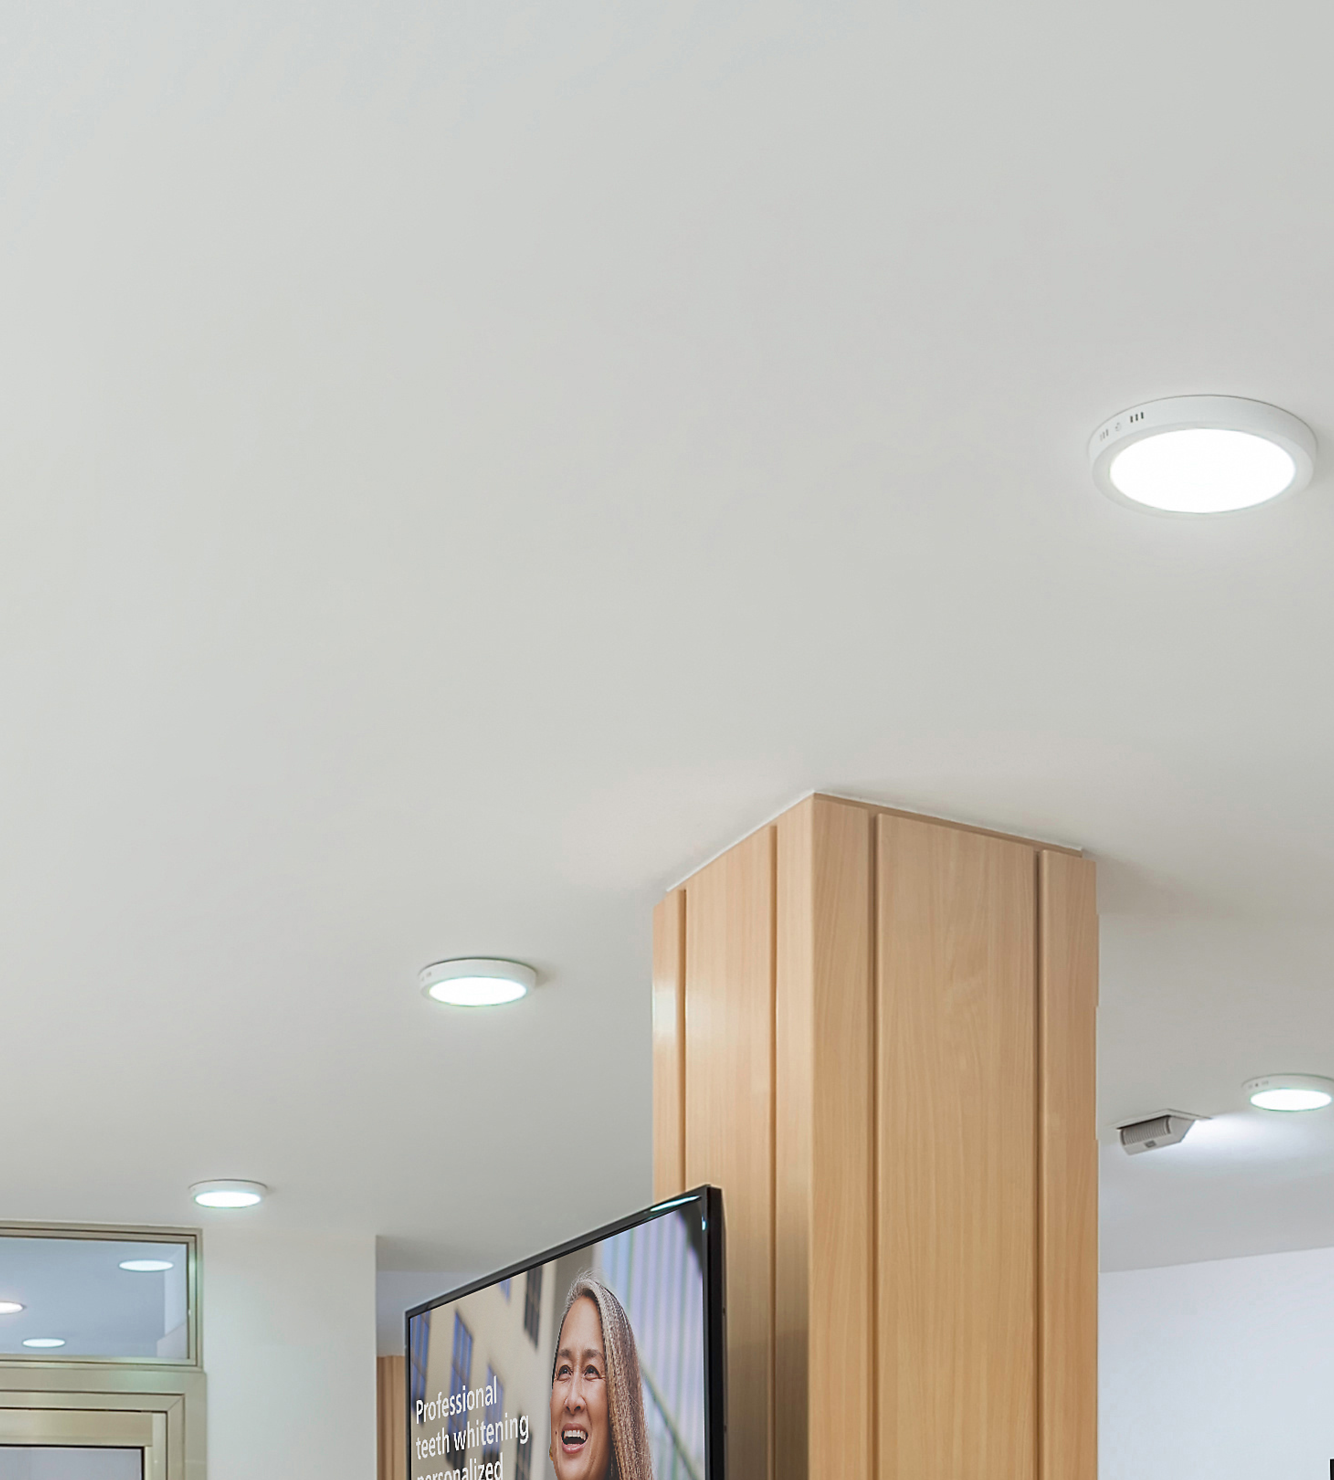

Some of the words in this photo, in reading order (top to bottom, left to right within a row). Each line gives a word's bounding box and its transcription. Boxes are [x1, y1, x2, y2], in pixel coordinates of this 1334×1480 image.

[416, 1375, 497, 1424] Professional
[416, 1427, 450, 1460] teeth
[453, 1413, 529, 1451] whitening
